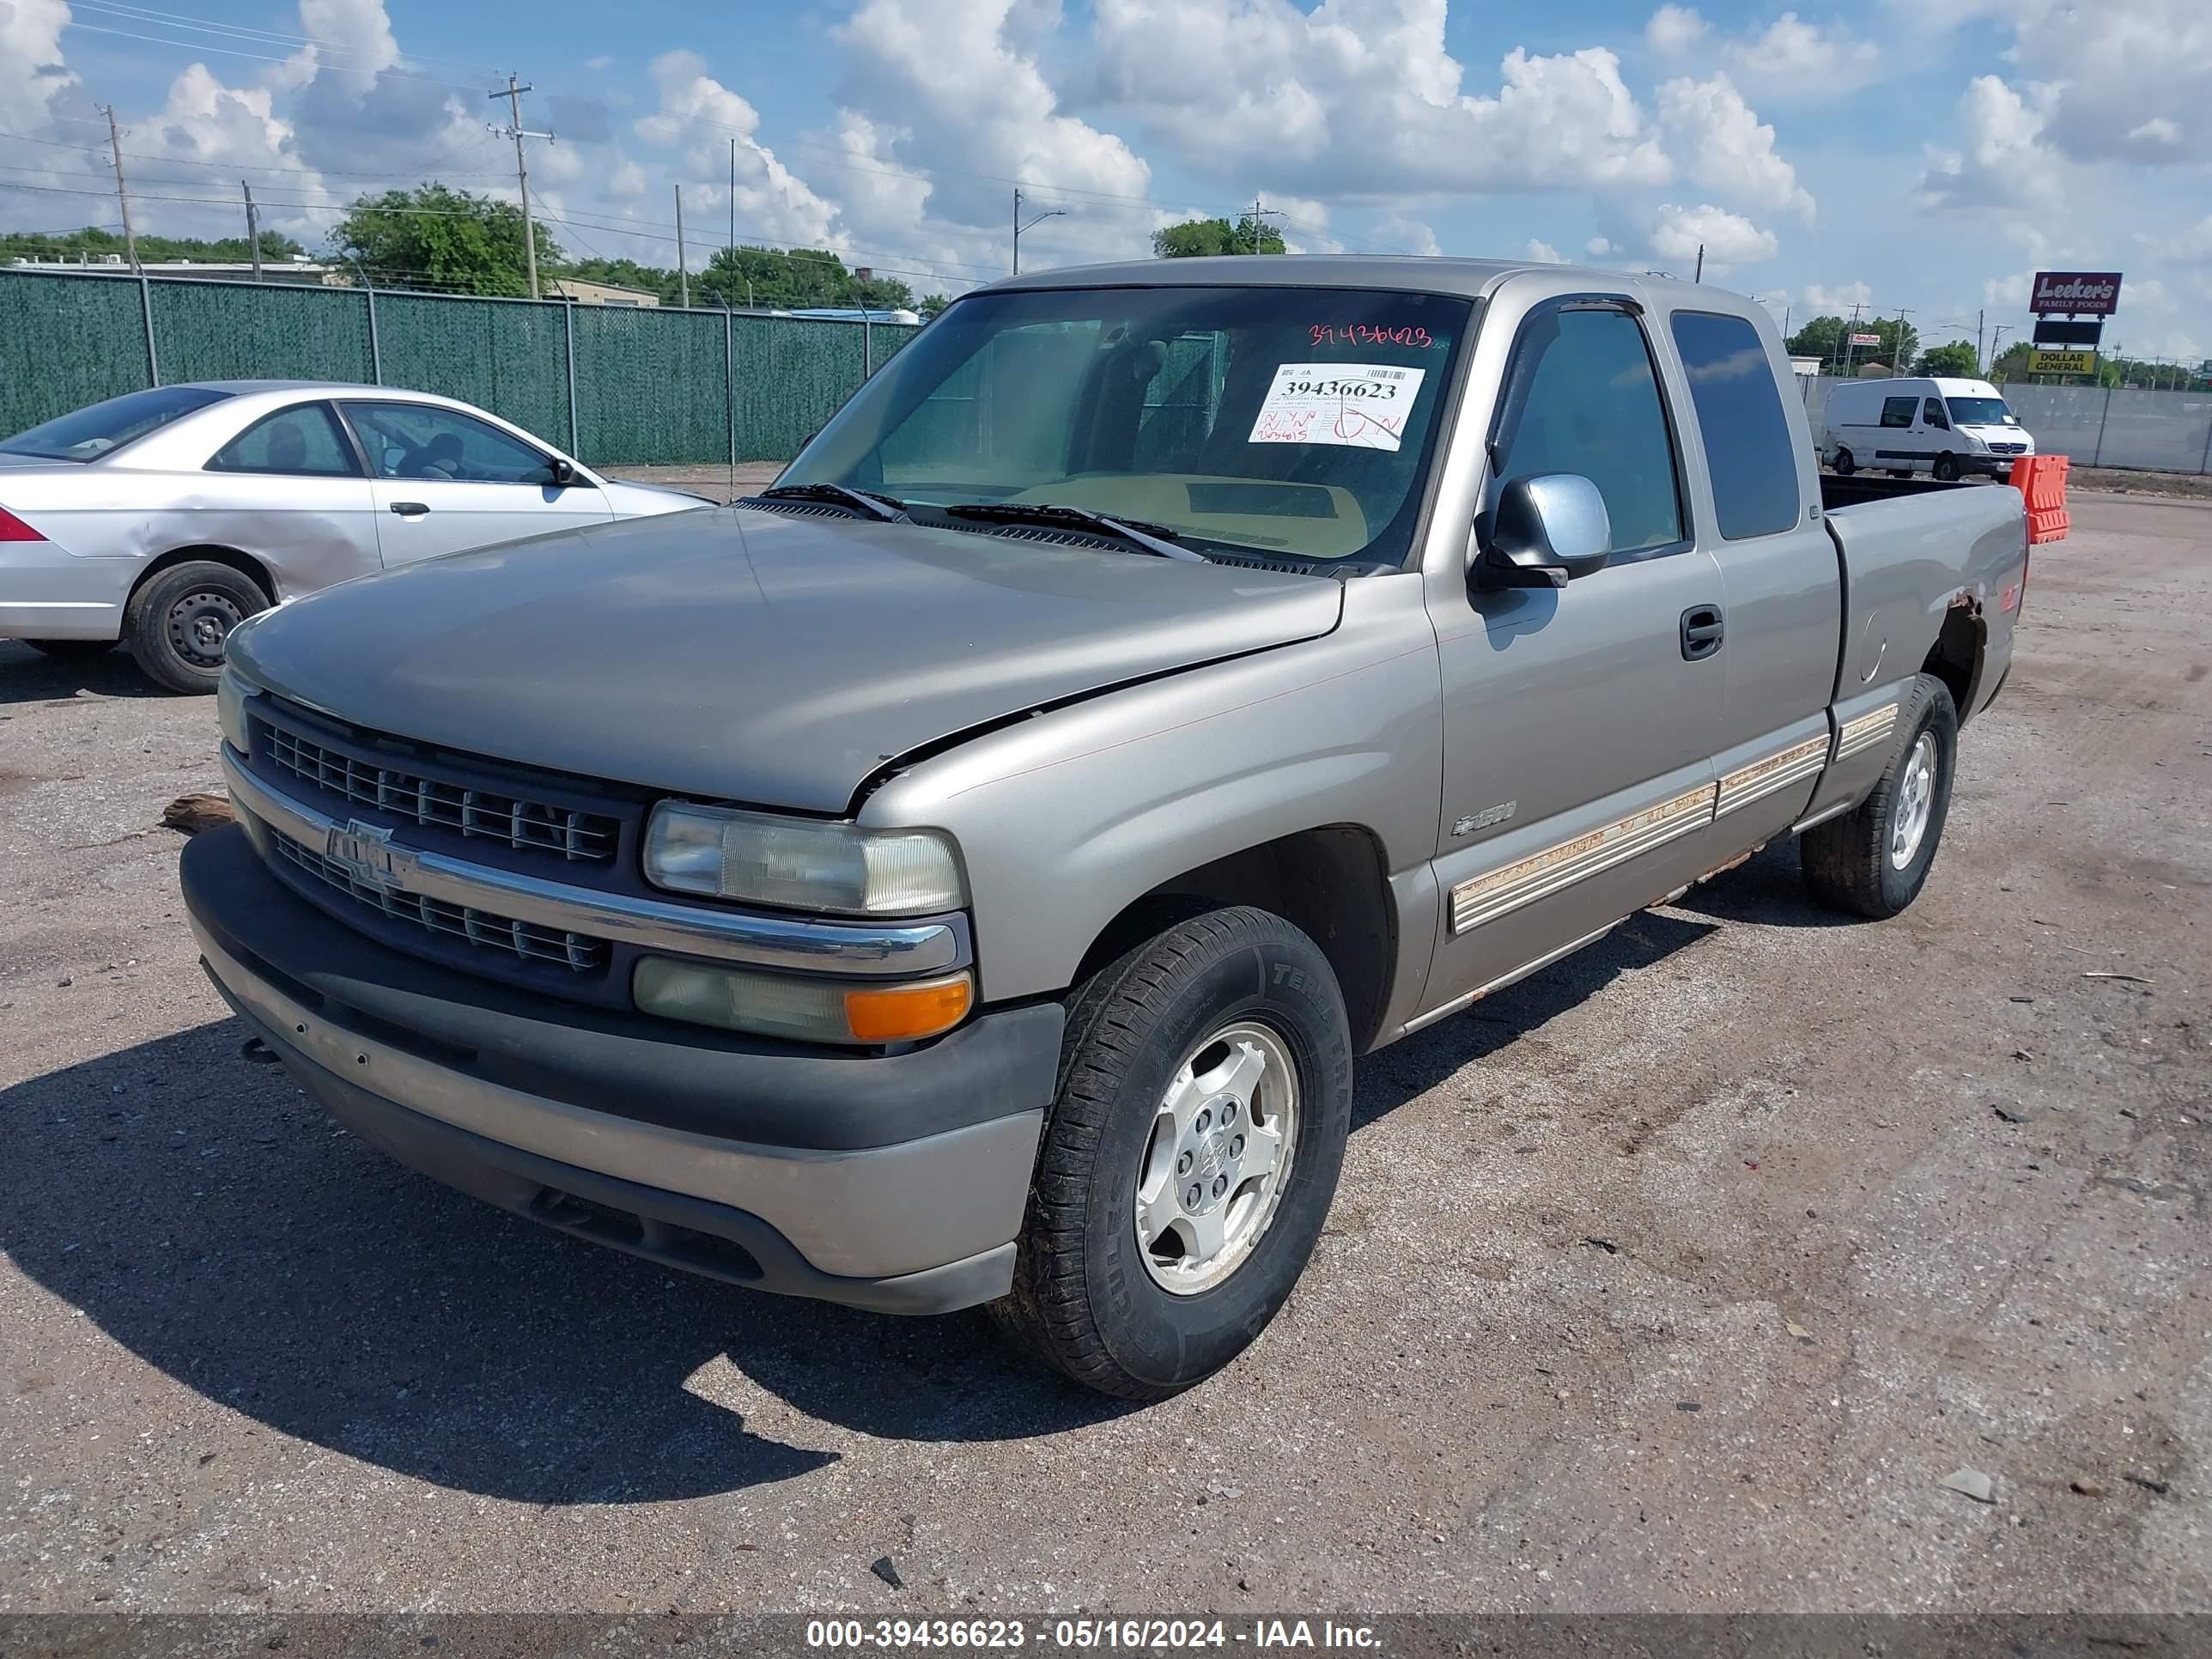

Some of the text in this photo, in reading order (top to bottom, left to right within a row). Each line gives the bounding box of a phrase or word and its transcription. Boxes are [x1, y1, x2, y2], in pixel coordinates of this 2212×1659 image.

[2037, 276, 2115, 300] Leeker's
[2040, 353, 2085, 362] DOLLAR
[2035, 362, 2086, 372] GENERAL
[1281, 380, 1397, 399] 39436623
